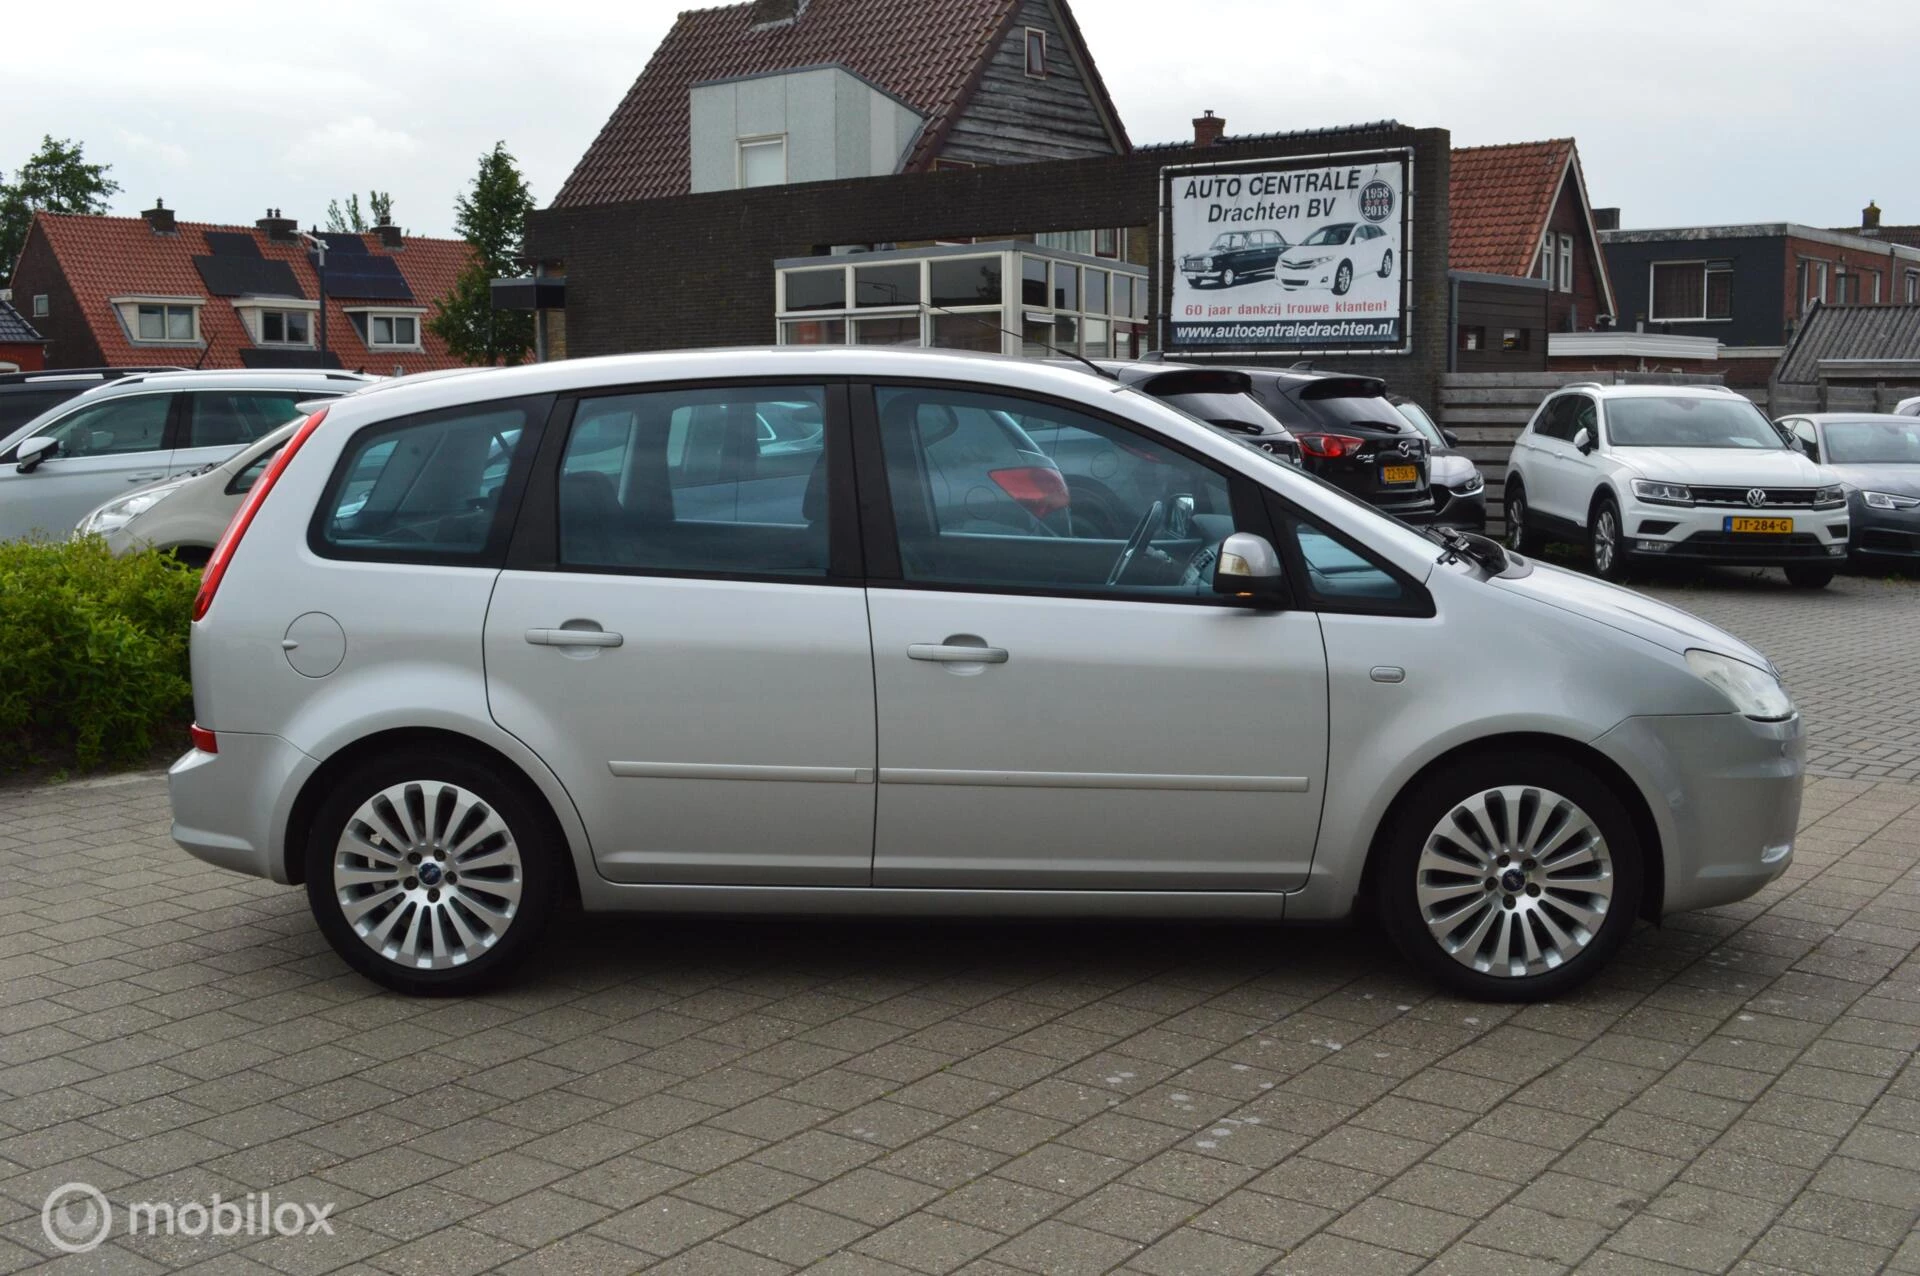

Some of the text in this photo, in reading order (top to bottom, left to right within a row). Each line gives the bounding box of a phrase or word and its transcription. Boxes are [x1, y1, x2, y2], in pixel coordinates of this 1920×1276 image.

[1184, 169, 1361, 200] AUTO CENTRALE
[1365, 188, 1389, 200] 1958
[1208, 197, 1336, 223] Drachten BV
[1364, 206, 1389, 217] 2018
[1185, 300, 1388, 317] 60 jaar dankzij trouwe klanten!
[1176, 320, 1394, 338] www.autocentraledrachten.nl
[1735, 519, 1788, 532] JT-284-G
